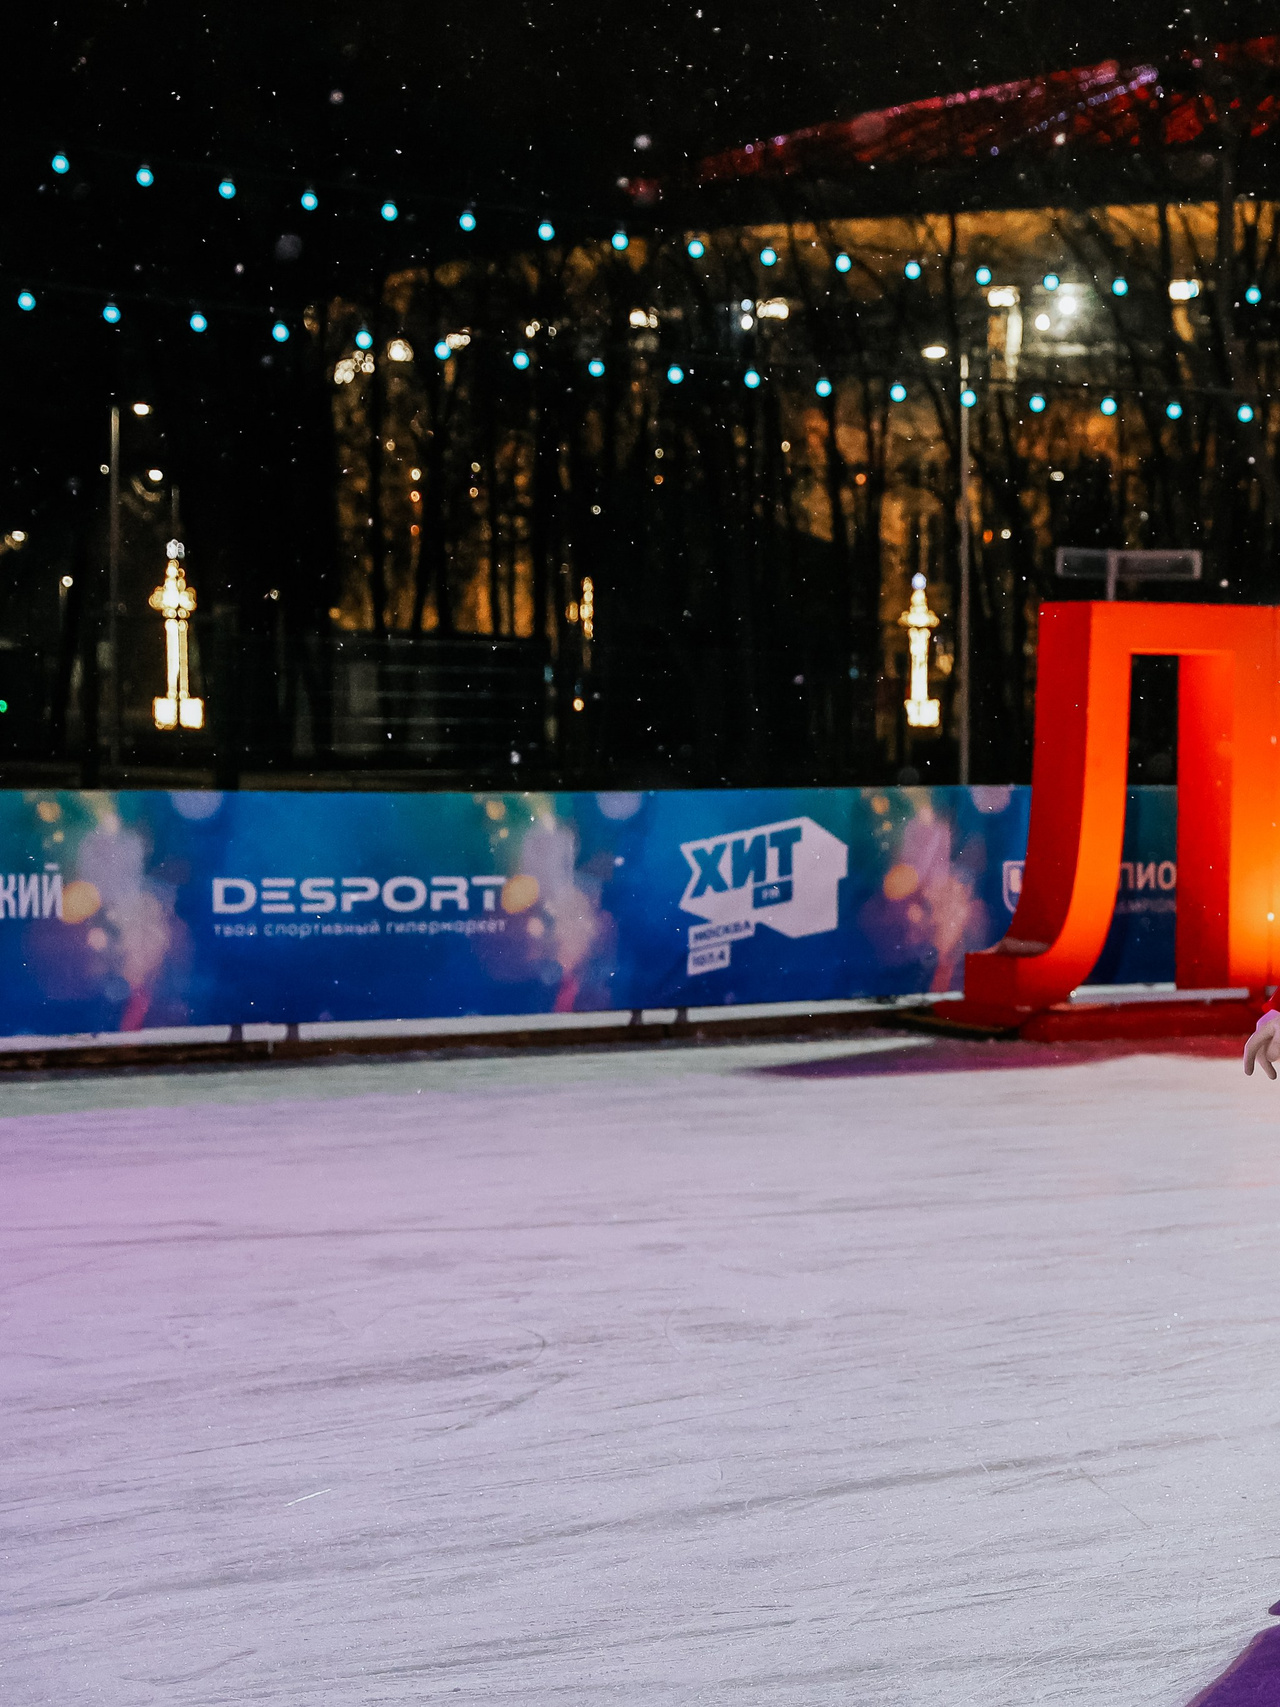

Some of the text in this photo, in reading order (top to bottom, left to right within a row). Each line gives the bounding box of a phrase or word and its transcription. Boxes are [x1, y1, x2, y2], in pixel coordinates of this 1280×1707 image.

[689, 826, 803, 900] ХИТ
[1118, 860, 1177, 891] ПИО
[0, 862, 63, 919] КИЙ
[211, 876, 507, 915] DESPORT
